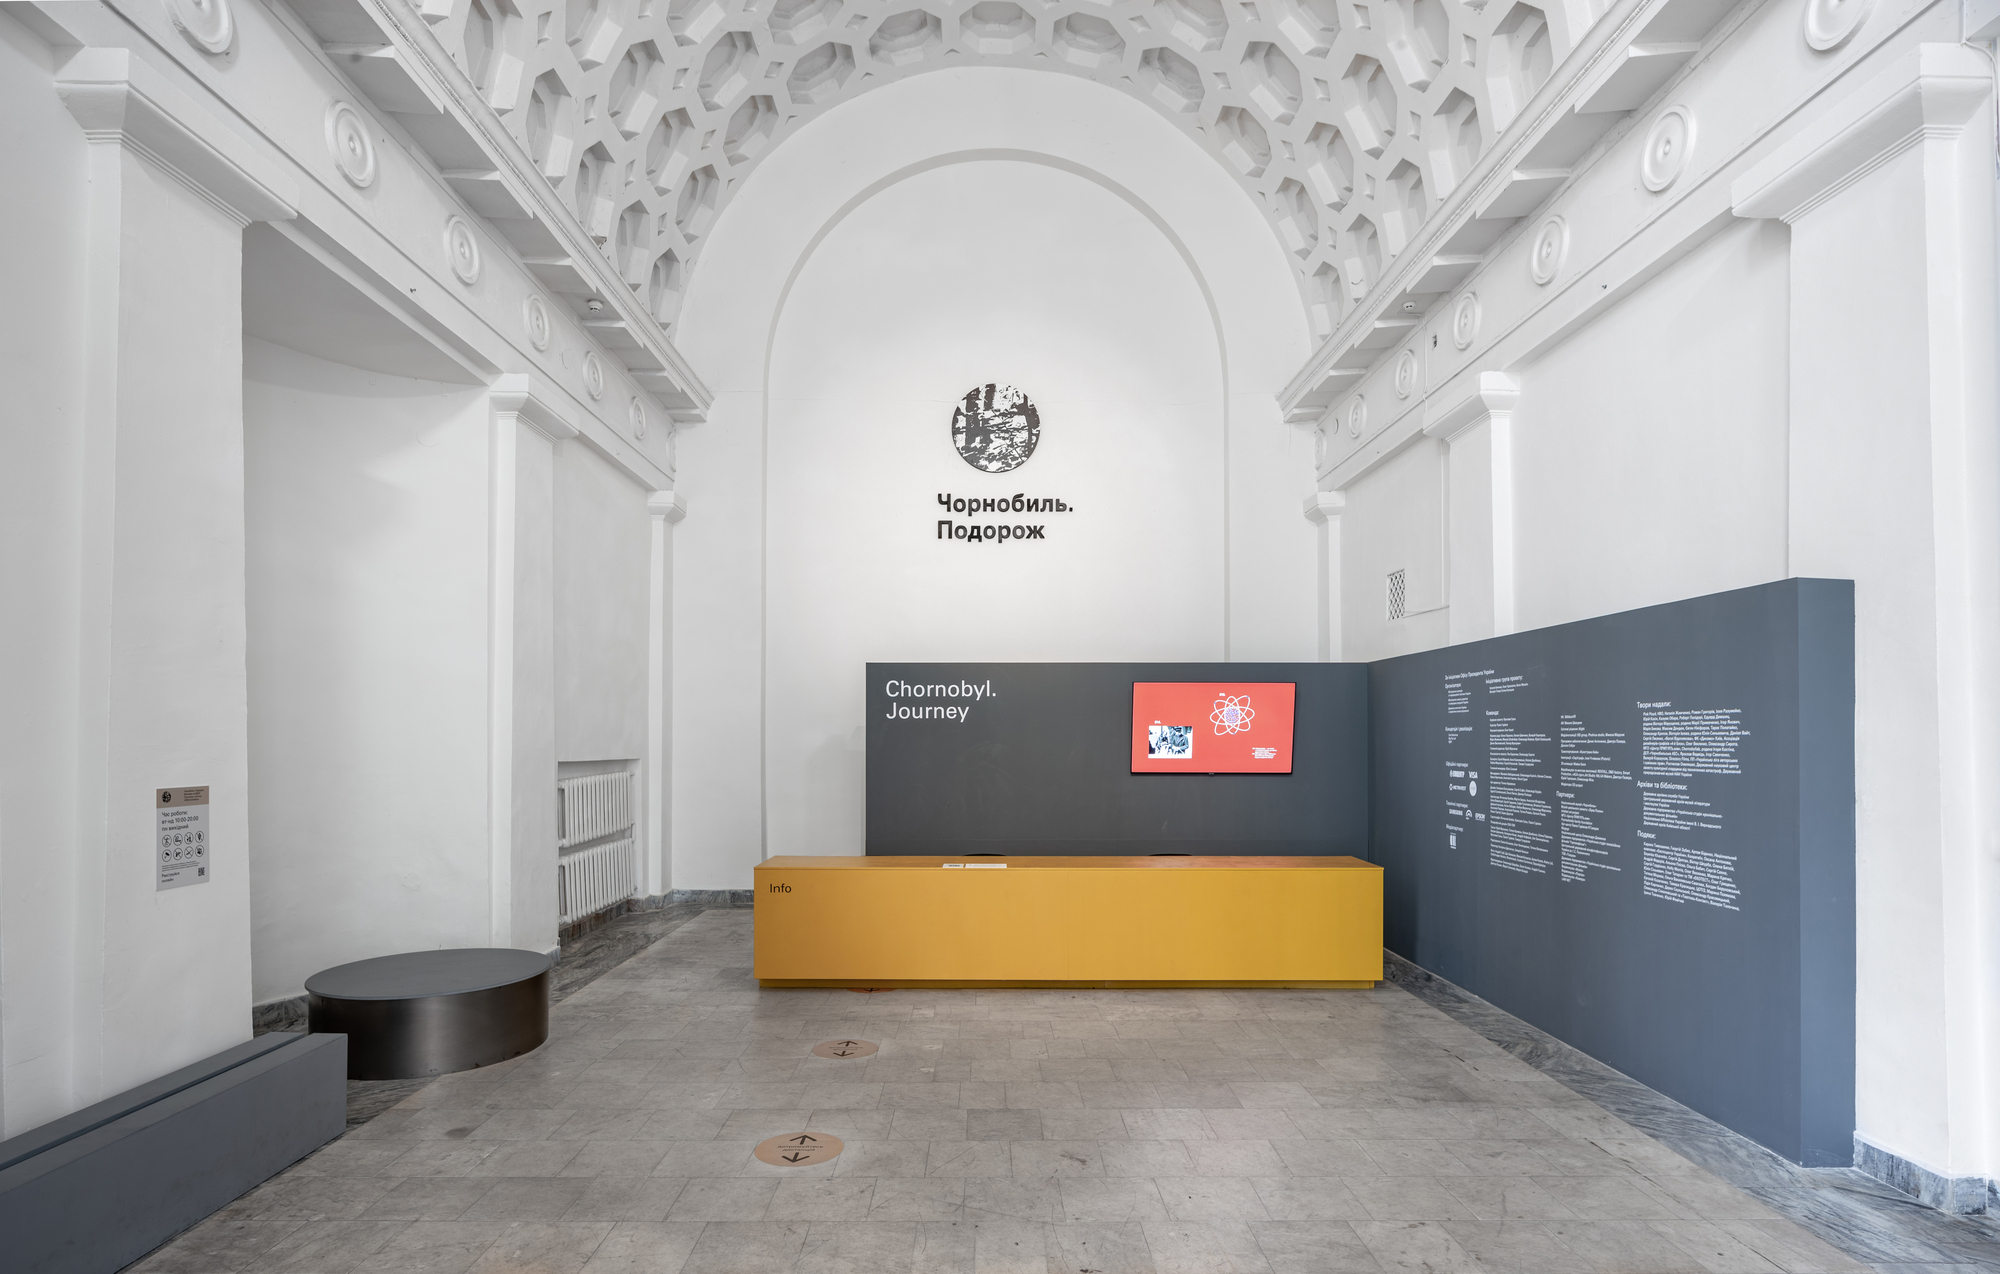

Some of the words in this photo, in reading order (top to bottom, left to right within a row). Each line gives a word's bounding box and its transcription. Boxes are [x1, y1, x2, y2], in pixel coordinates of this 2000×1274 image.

[938, 493, 1074, 516] Чорнобиль.
[938, 520, 1045, 543] Подорож
[886, 680, 996, 700] Chornobyl.
[886, 702, 970, 722] Journey
[1660, 782, 1688, 791] бібліотеки:
[769, 883, 792, 894] Info
